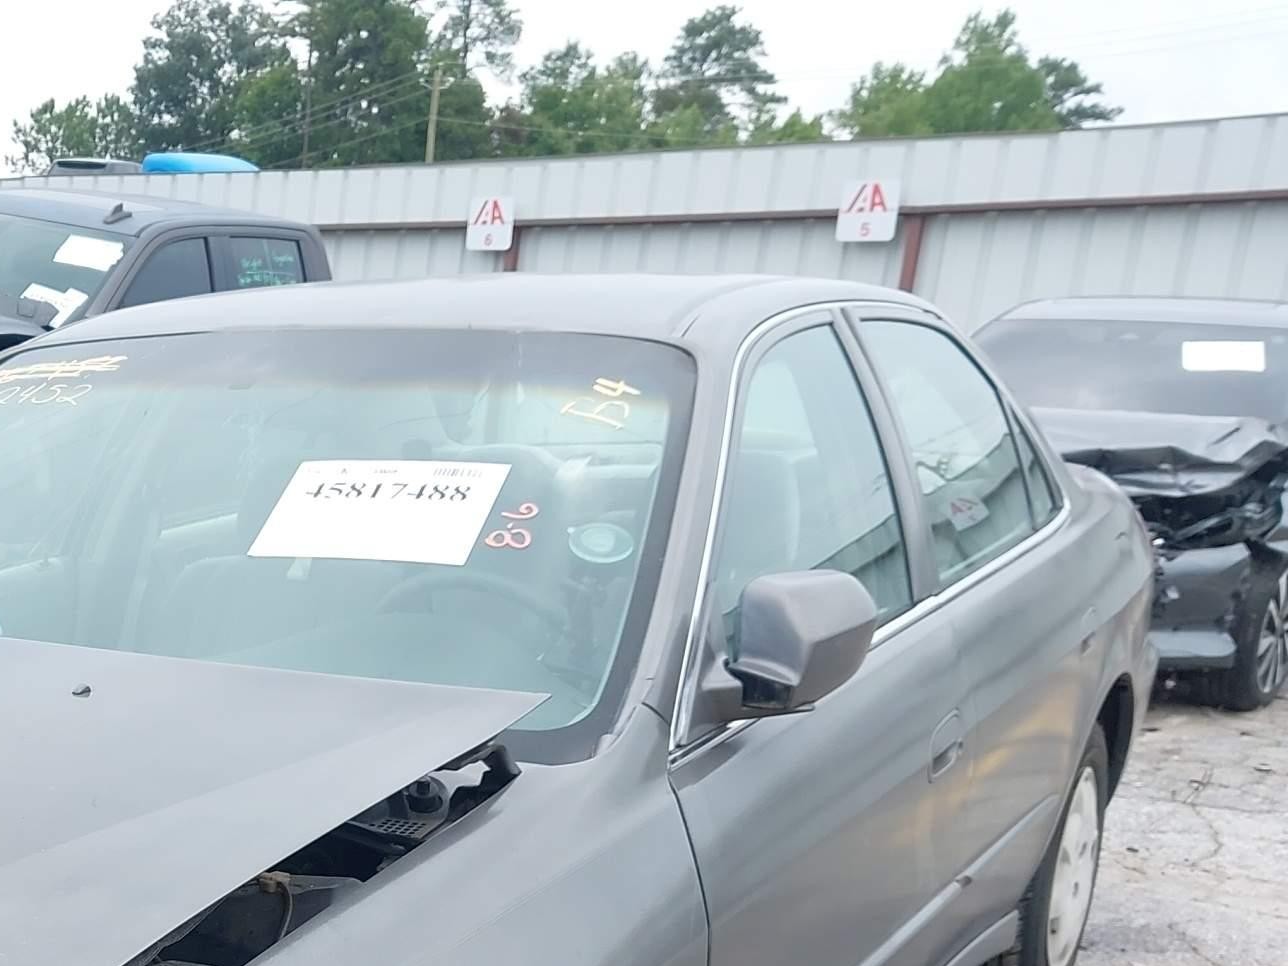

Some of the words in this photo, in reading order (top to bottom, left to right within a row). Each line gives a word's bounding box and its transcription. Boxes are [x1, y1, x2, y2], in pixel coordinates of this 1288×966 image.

[859, 221, 871, 238] 5
[483, 232, 493, 248] 6
[305, 481, 472, 502] 45817488
